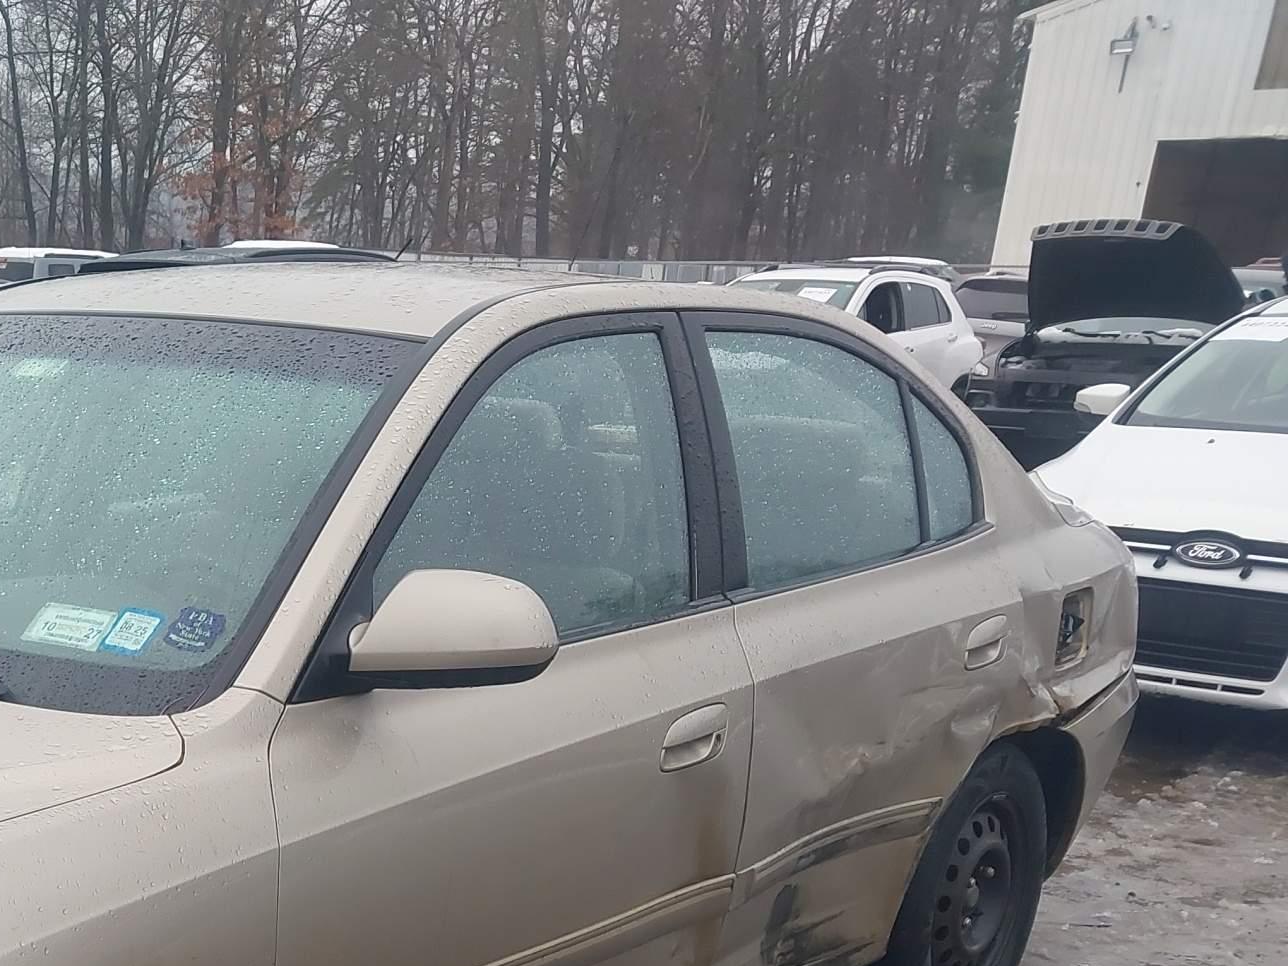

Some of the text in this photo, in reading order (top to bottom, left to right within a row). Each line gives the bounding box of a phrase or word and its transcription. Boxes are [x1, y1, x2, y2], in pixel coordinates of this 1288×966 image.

[1188, 544, 1225, 560] Ford
[41, 621, 57, 631] 10
[83, 627, 103, 639] 27
